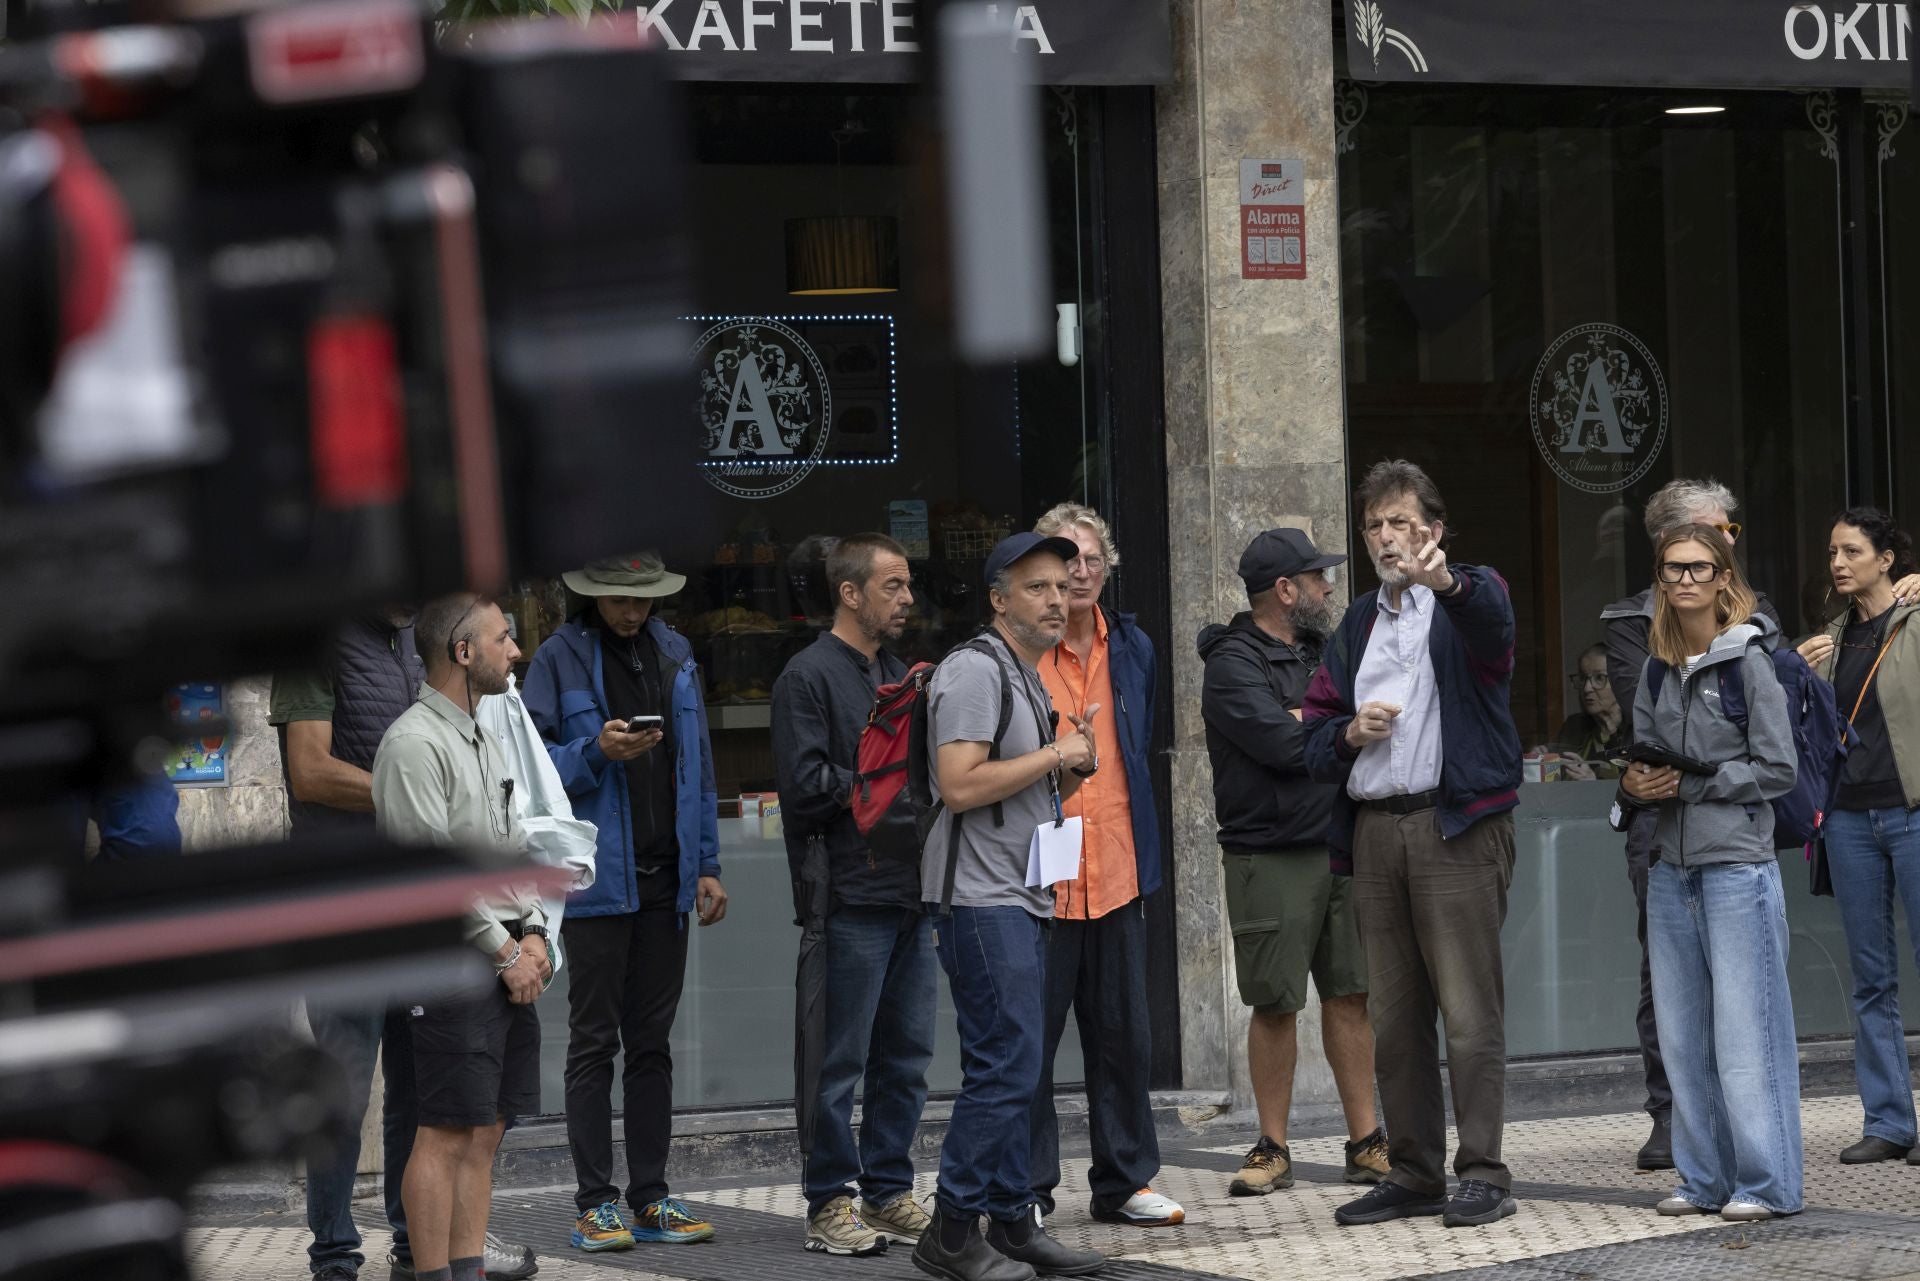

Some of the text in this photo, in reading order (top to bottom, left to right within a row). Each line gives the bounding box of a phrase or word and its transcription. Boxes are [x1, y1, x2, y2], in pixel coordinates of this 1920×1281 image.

[636, 0, 1056, 54] KAFETEA
[1252, 179, 1294, 200] Direct
[1247, 209, 1300, 225] Alarma
